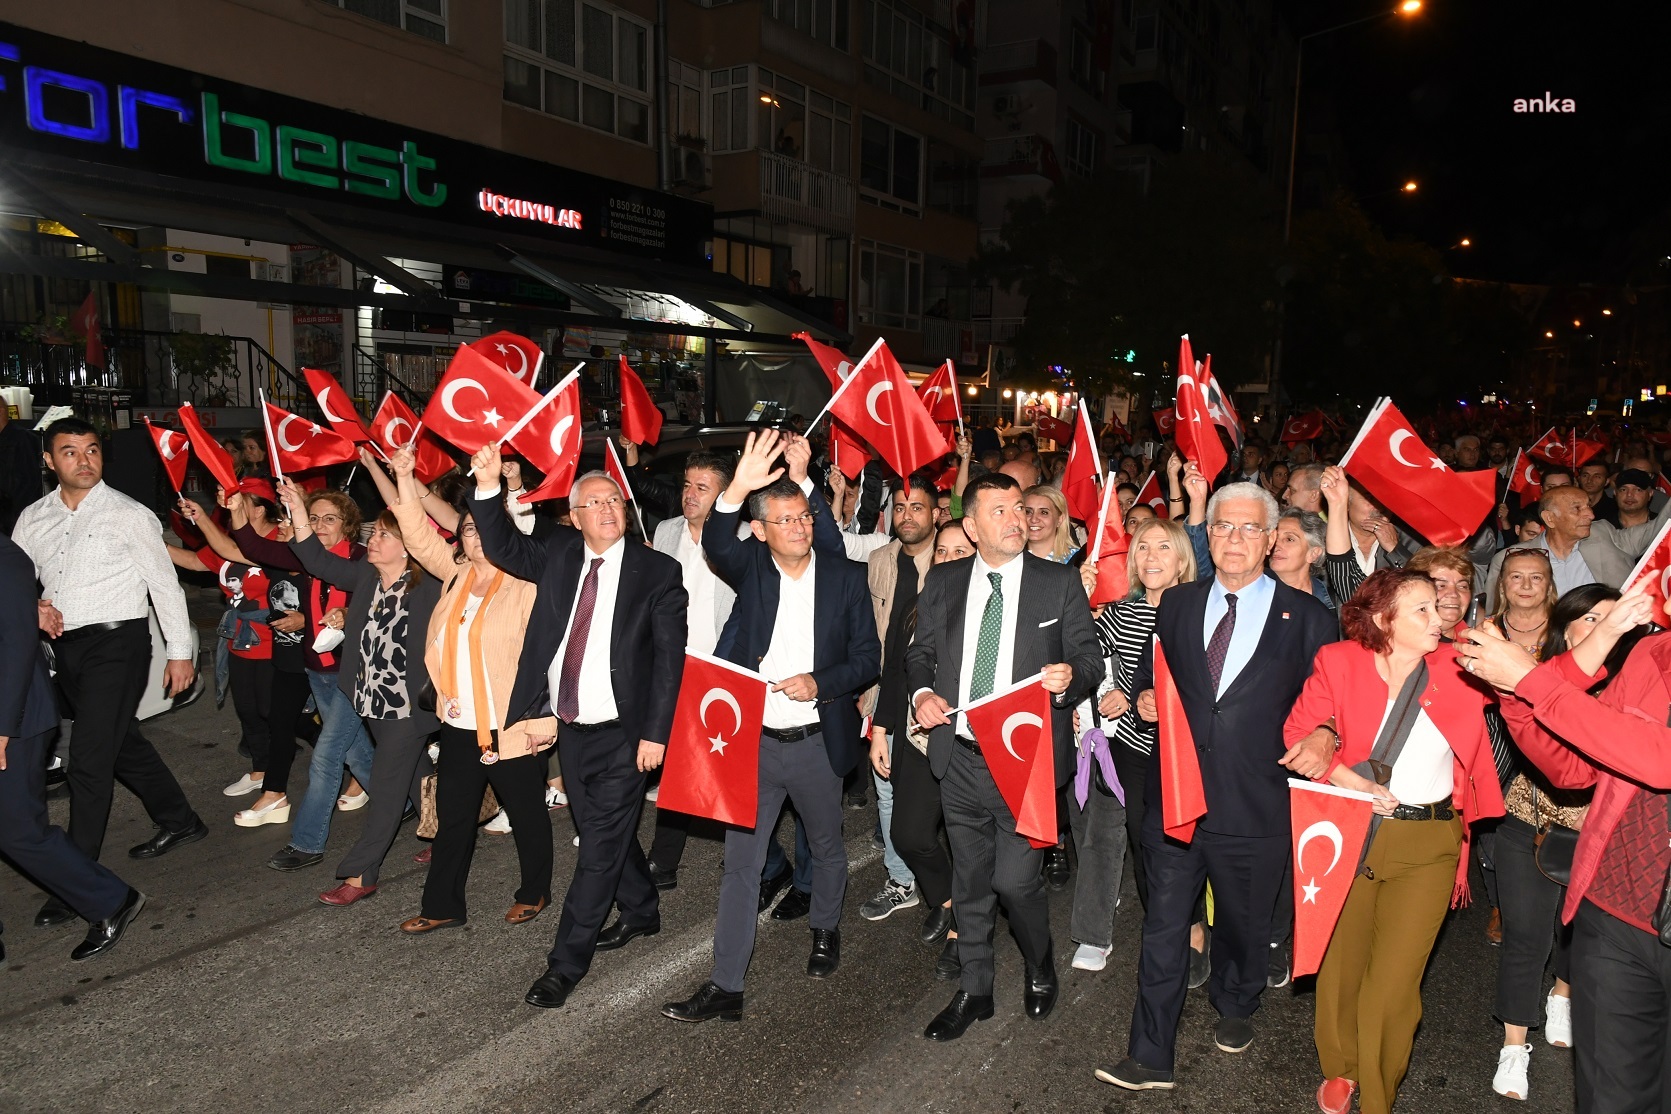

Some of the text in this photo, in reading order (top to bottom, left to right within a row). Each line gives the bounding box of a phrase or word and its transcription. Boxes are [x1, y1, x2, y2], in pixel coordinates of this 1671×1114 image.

[478, 187, 582, 230] ÜÇKUYULAR
[609, 197, 666, 219] 0 850 221 0 300
[610, 211, 666, 229] www.forbest.com.tr
[610, 220, 666, 238] forbestmagazalari
[610, 230, 666, 248] forbestmagazalari
